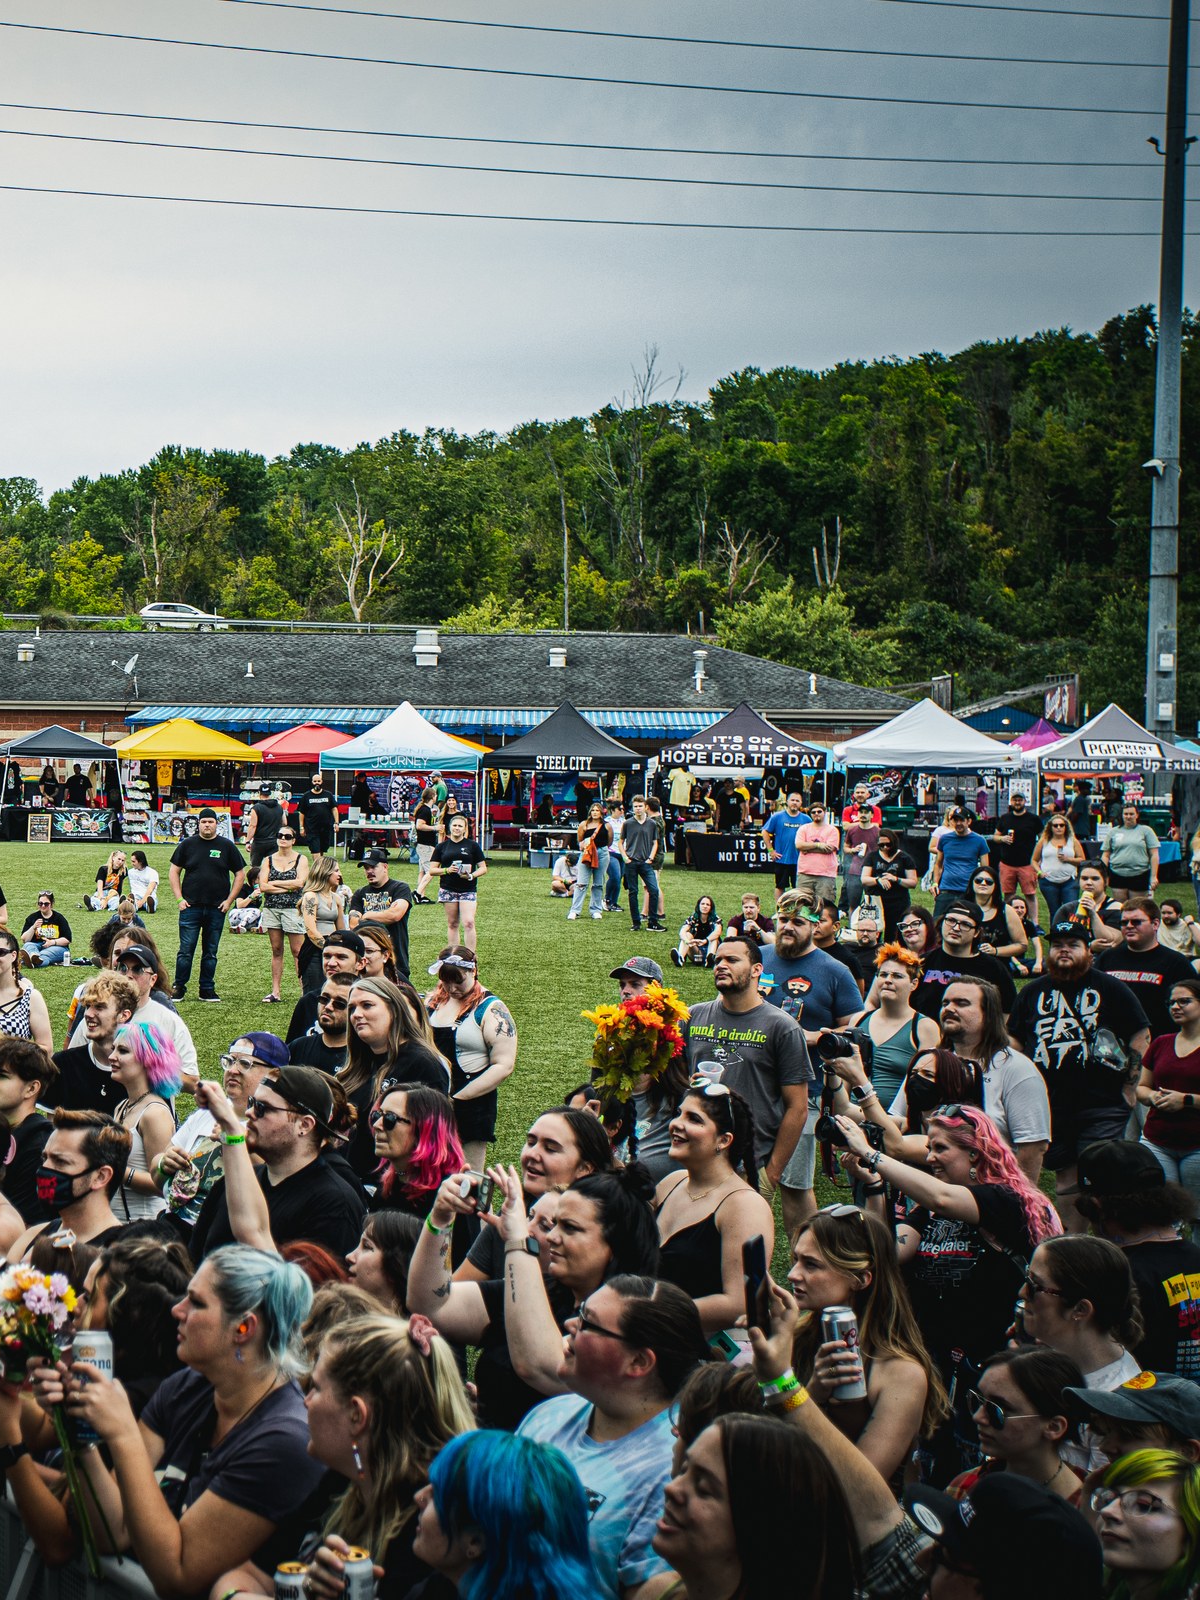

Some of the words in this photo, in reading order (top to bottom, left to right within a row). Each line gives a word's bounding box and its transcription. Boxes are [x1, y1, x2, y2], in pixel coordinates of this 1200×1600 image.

[712, 735, 744, 744] IT'S
[1089, 743, 1118, 755] PGH
[1117, 744, 1153, 752] PRINT
[371, 755, 429, 769] JOURNEY
[536, 755, 567, 771] STEEL
[569, 756, 593, 771] CITY
[661, 750, 707, 764] HOPE
[711, 752, 746, 766] FOR
[751, 753, 783, 767] THE
[787, 754, 820, 768] DAY
[1041, 757, 1105, 770] Customer
[1109, 758, 1160, 773] Pop-Up
[718, 852, 739, 862] NOT
[743, 852, 757, 862] TO
[760, 852, 773, 862] BE
[689, 1023, 715, 1038] punk
[717, 1027, 728, 1039] in
[728, 1028, 767, 1043] drublic
